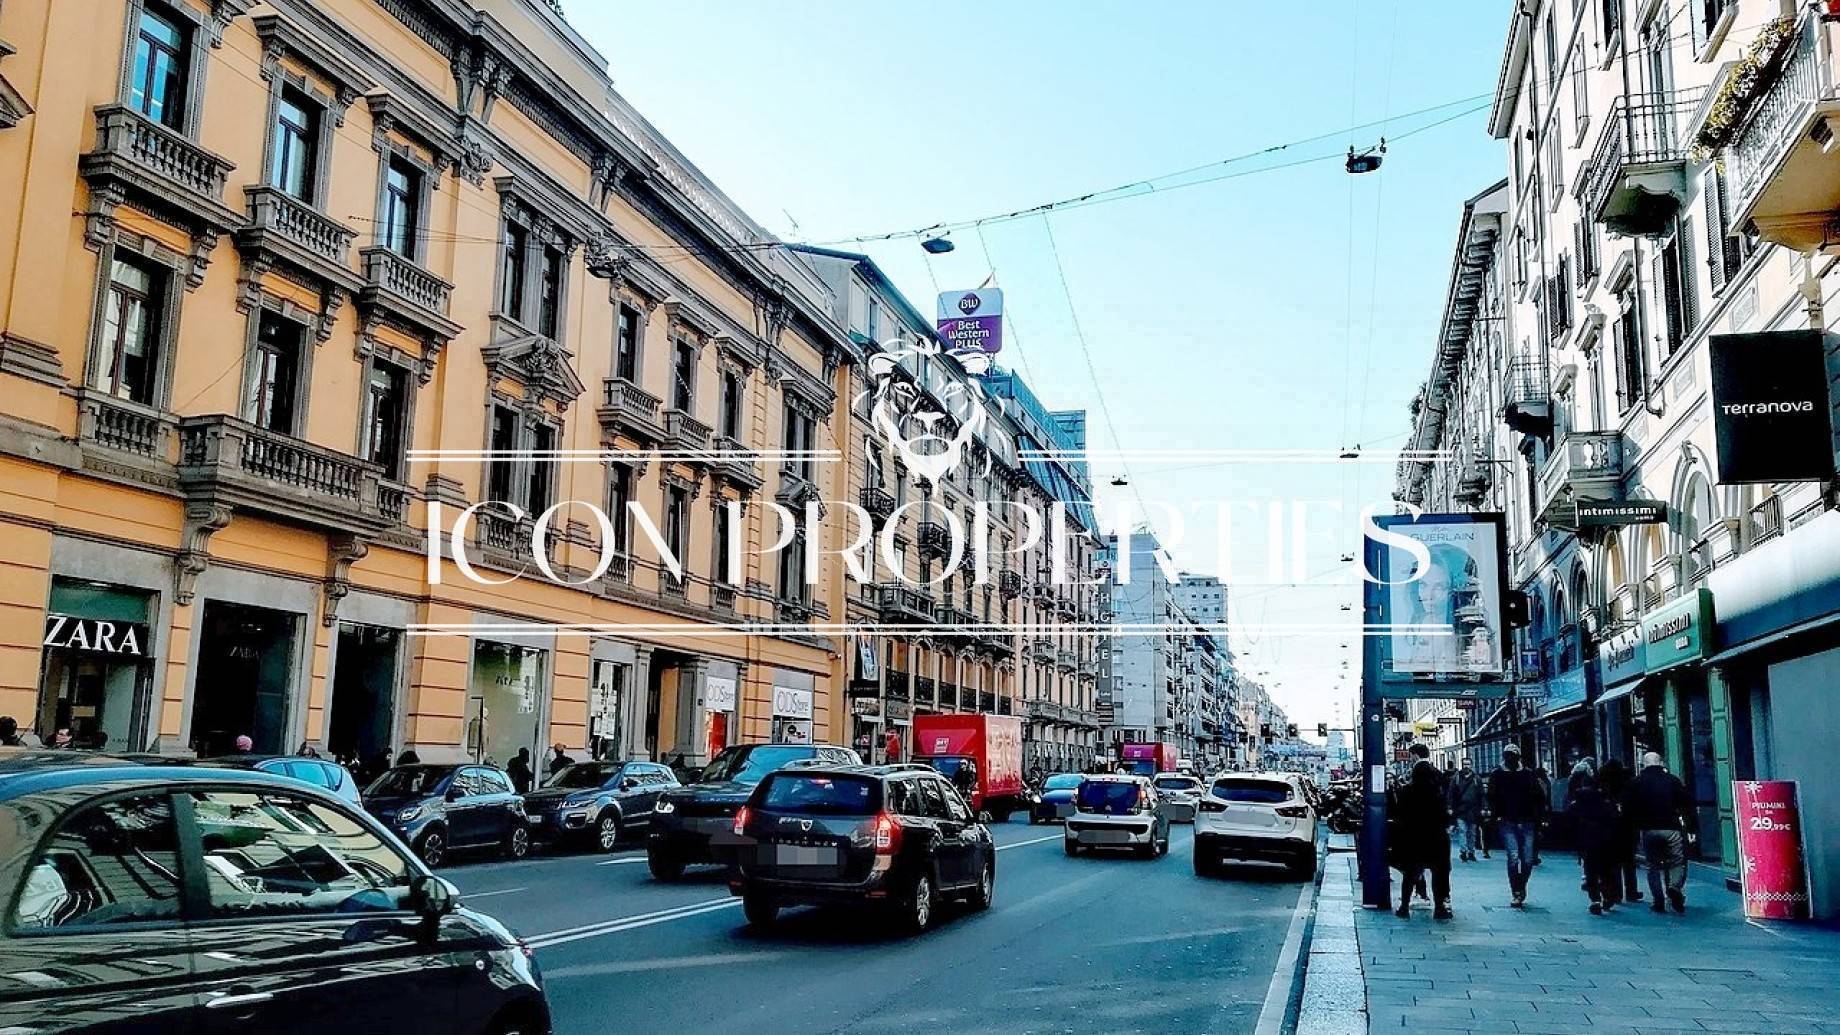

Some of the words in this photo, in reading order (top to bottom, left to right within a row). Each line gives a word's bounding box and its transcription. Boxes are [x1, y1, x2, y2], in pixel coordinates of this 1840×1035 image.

[961, 299, 978, 309] BW
[958, 321, 981, 330] Best
[948, 329, 990, 339] Western
[1579, 507, 1657, 516] intimissimi
[1410, 532, 1475, 542] GUERLAIN
[43, 615, 142, 655] ZARA
